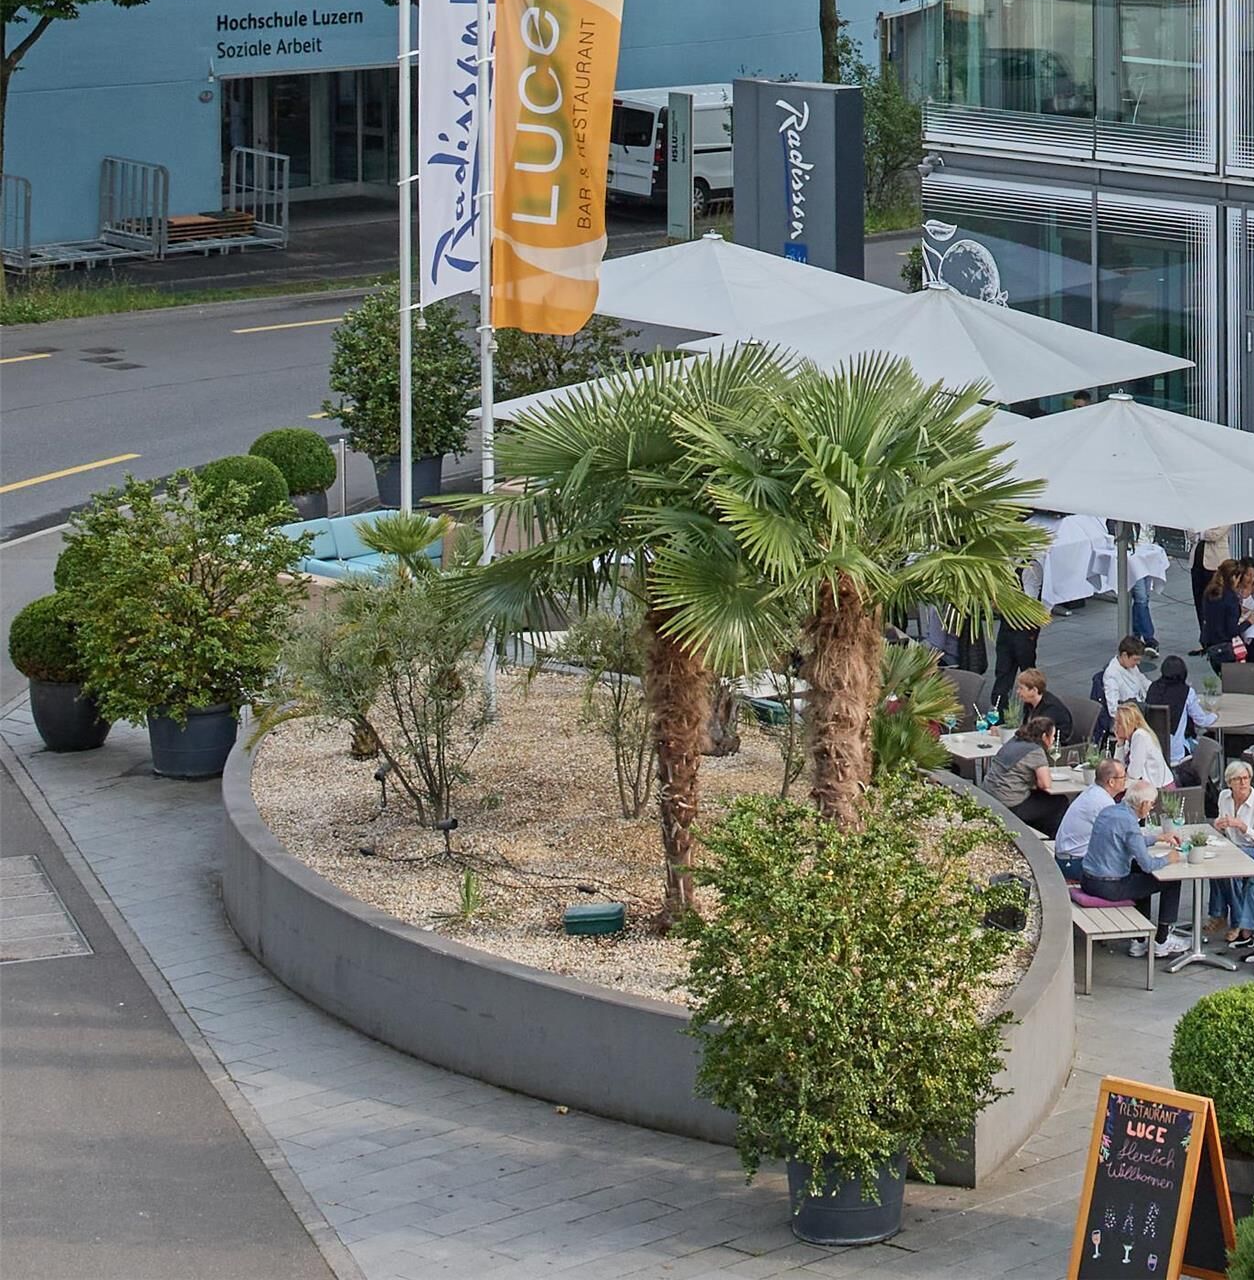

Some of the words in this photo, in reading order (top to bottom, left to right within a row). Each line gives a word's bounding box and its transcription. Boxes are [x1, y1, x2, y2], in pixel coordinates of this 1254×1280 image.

[217, 10, 308, 32] Hochschule
[313, 9, 363, 27] Luzern
[217, 39, 272, 59] Soziale
[276, 37, 323, 55] Arbeit
[776, 99, 815, 240] Radisson
[577, 188, 592, 229] BAR
[1119, 1102, 1179, 1124] RESTAURANT
[1126, 1121, 1168, 1143] LUCE
